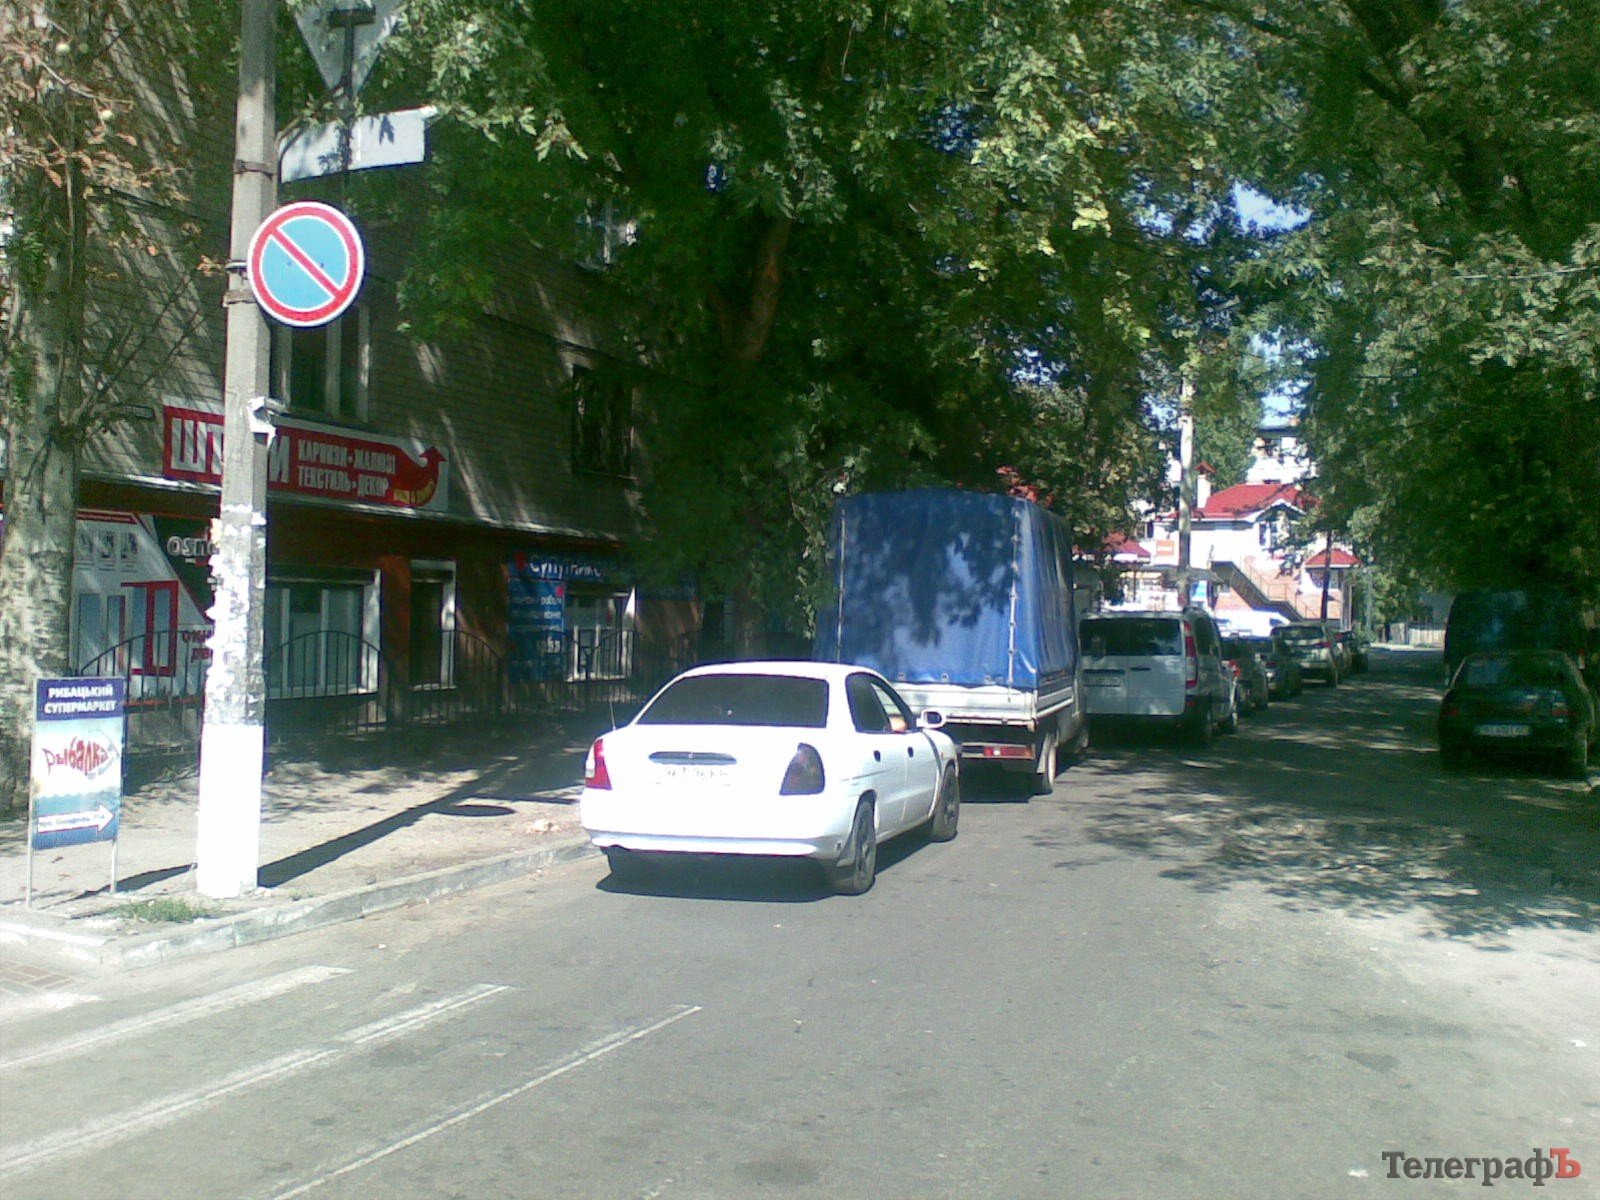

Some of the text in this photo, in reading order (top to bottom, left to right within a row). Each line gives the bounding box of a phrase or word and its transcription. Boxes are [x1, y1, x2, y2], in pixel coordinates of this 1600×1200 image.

[171, 417, 291, 483] ШТИ
[298, 465, 351, 493] ТЕКСТИЛЬ
[357, 474, 390, 498] ДЕКОР
[48, 684, 114, 699] РИБАЦЬКИЙ
[44, 700, 117, 714] СУПЕРМАРКЕТ
